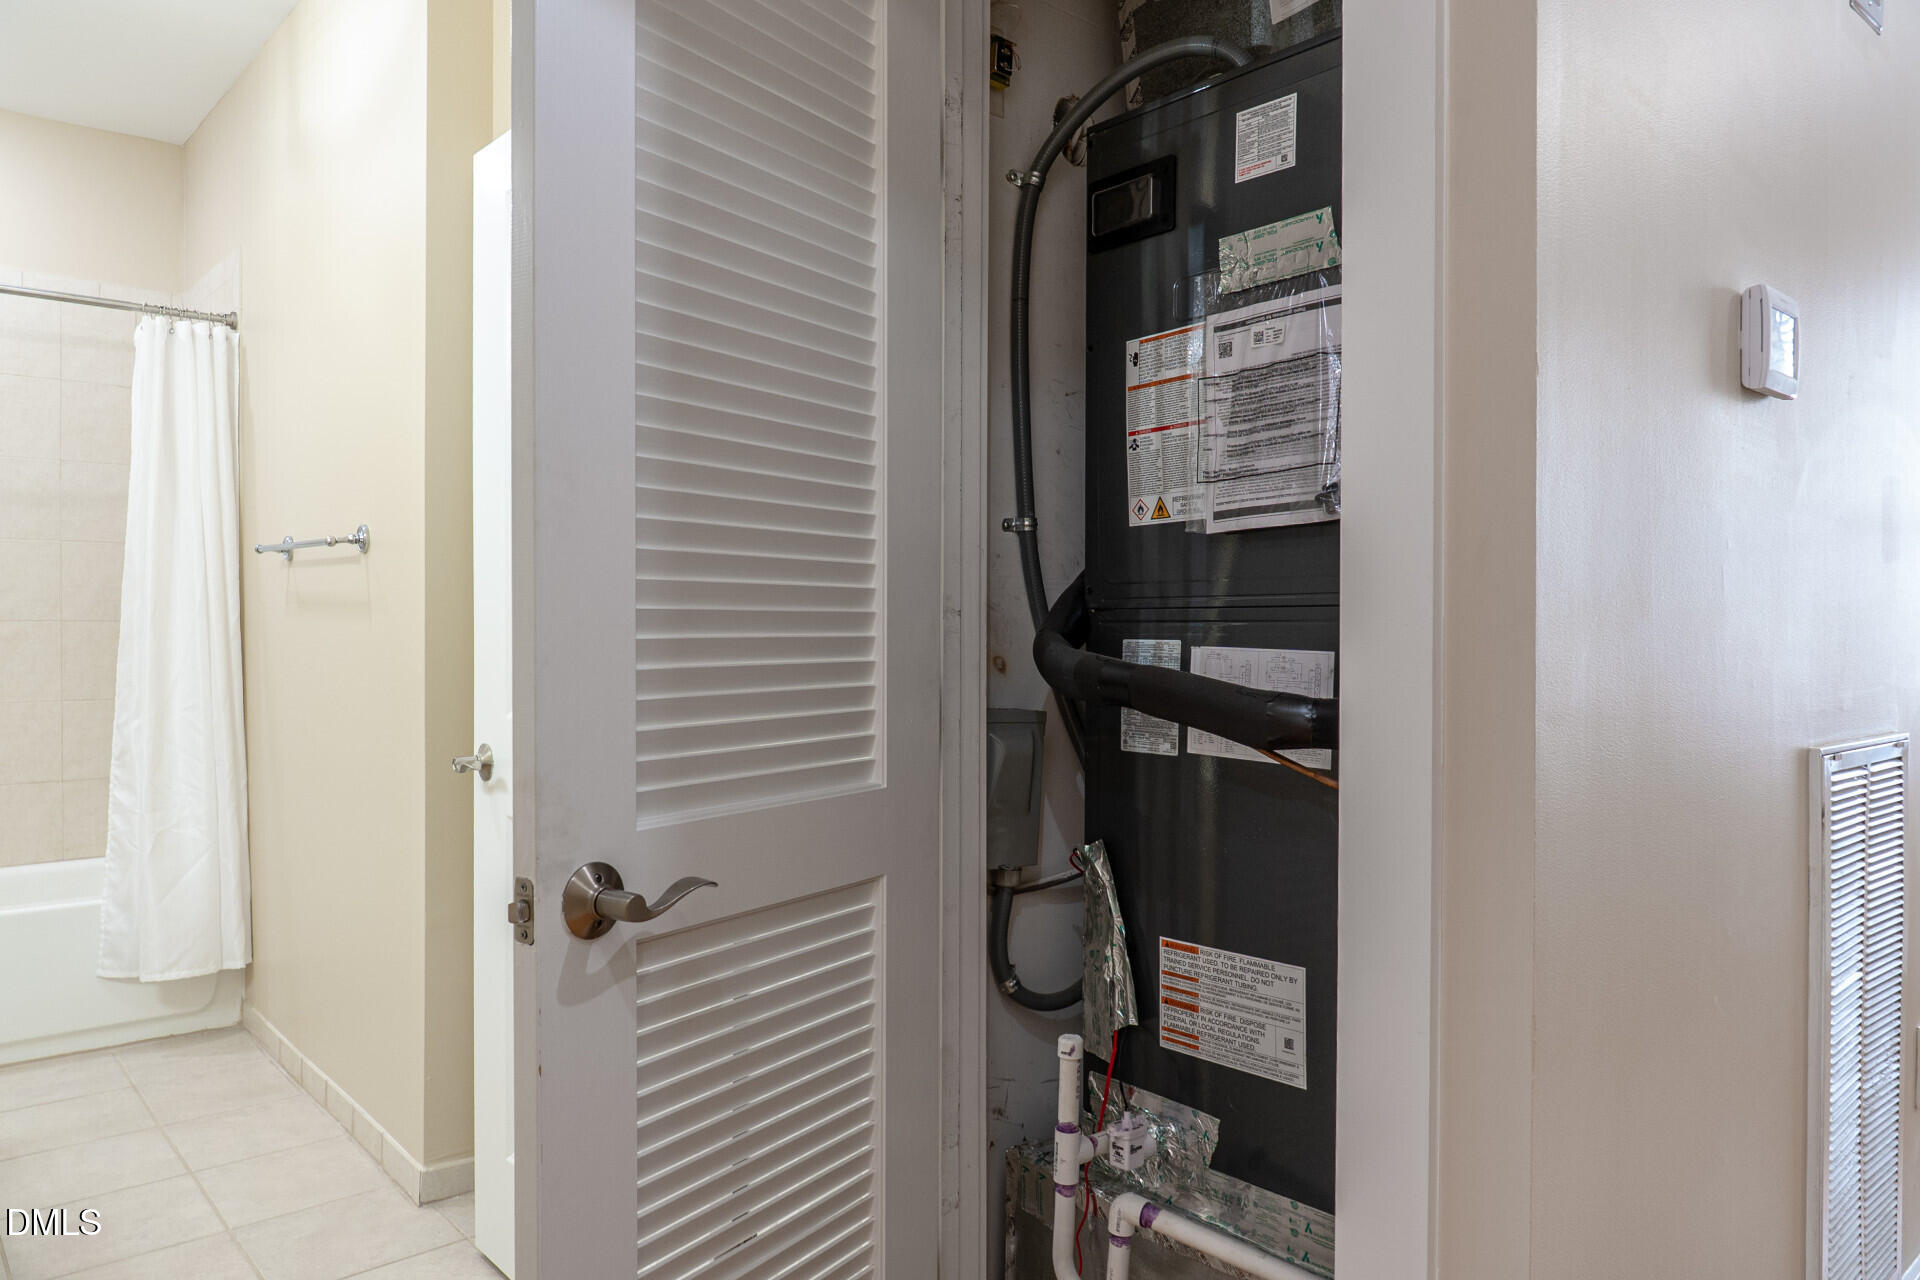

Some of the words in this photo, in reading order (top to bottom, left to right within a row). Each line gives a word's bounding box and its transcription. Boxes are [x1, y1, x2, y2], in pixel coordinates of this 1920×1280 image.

[1163, 948, 1200, 962] REFRIGERANT
[1229, 963, 1237, 971] BE
[1239, 965, 1269, 978] REPAIRED
[1270, 972, 1287, 982] ONLY
[1288, 976, 1297, 985] BY
[1163, 956, 1186, 967] TRAINED
[1187, 961, 1211, 972] SERVICE
[1250, 976, 1259, 984] DO
[1261, 978, 1274, 988] NOT
[1199, 949, 1212, 958] RISK
[1214, 952, 1222, 960] OF
[1239, 958, 1275, 972] FLAMMABLE
[1163, 963, 1192, 975] PUNCTURE
[1193, 970, 1233, 985] REFRIGERANT
[1163, 1012, 1187, 1024] FEDERAL
[1188, 1019, 1196, 1027] OR
[1198, 1022, 1216, 1032] LOCAL
[1199, 1007, 1212, 1016] RISK
[1214, 1011, 1222, 1019] OF
[1239, 1017, 1265, 1030] DISPOSE
[1207, 1016, 1247, 1033] ACCORDANCE
[1249, 1028, 1264, 1038] WITH
[1163, 1019, 1195, 1034] FLAMMABLE
[1196, 1028, 1237, 1046] REFRIGERANT
